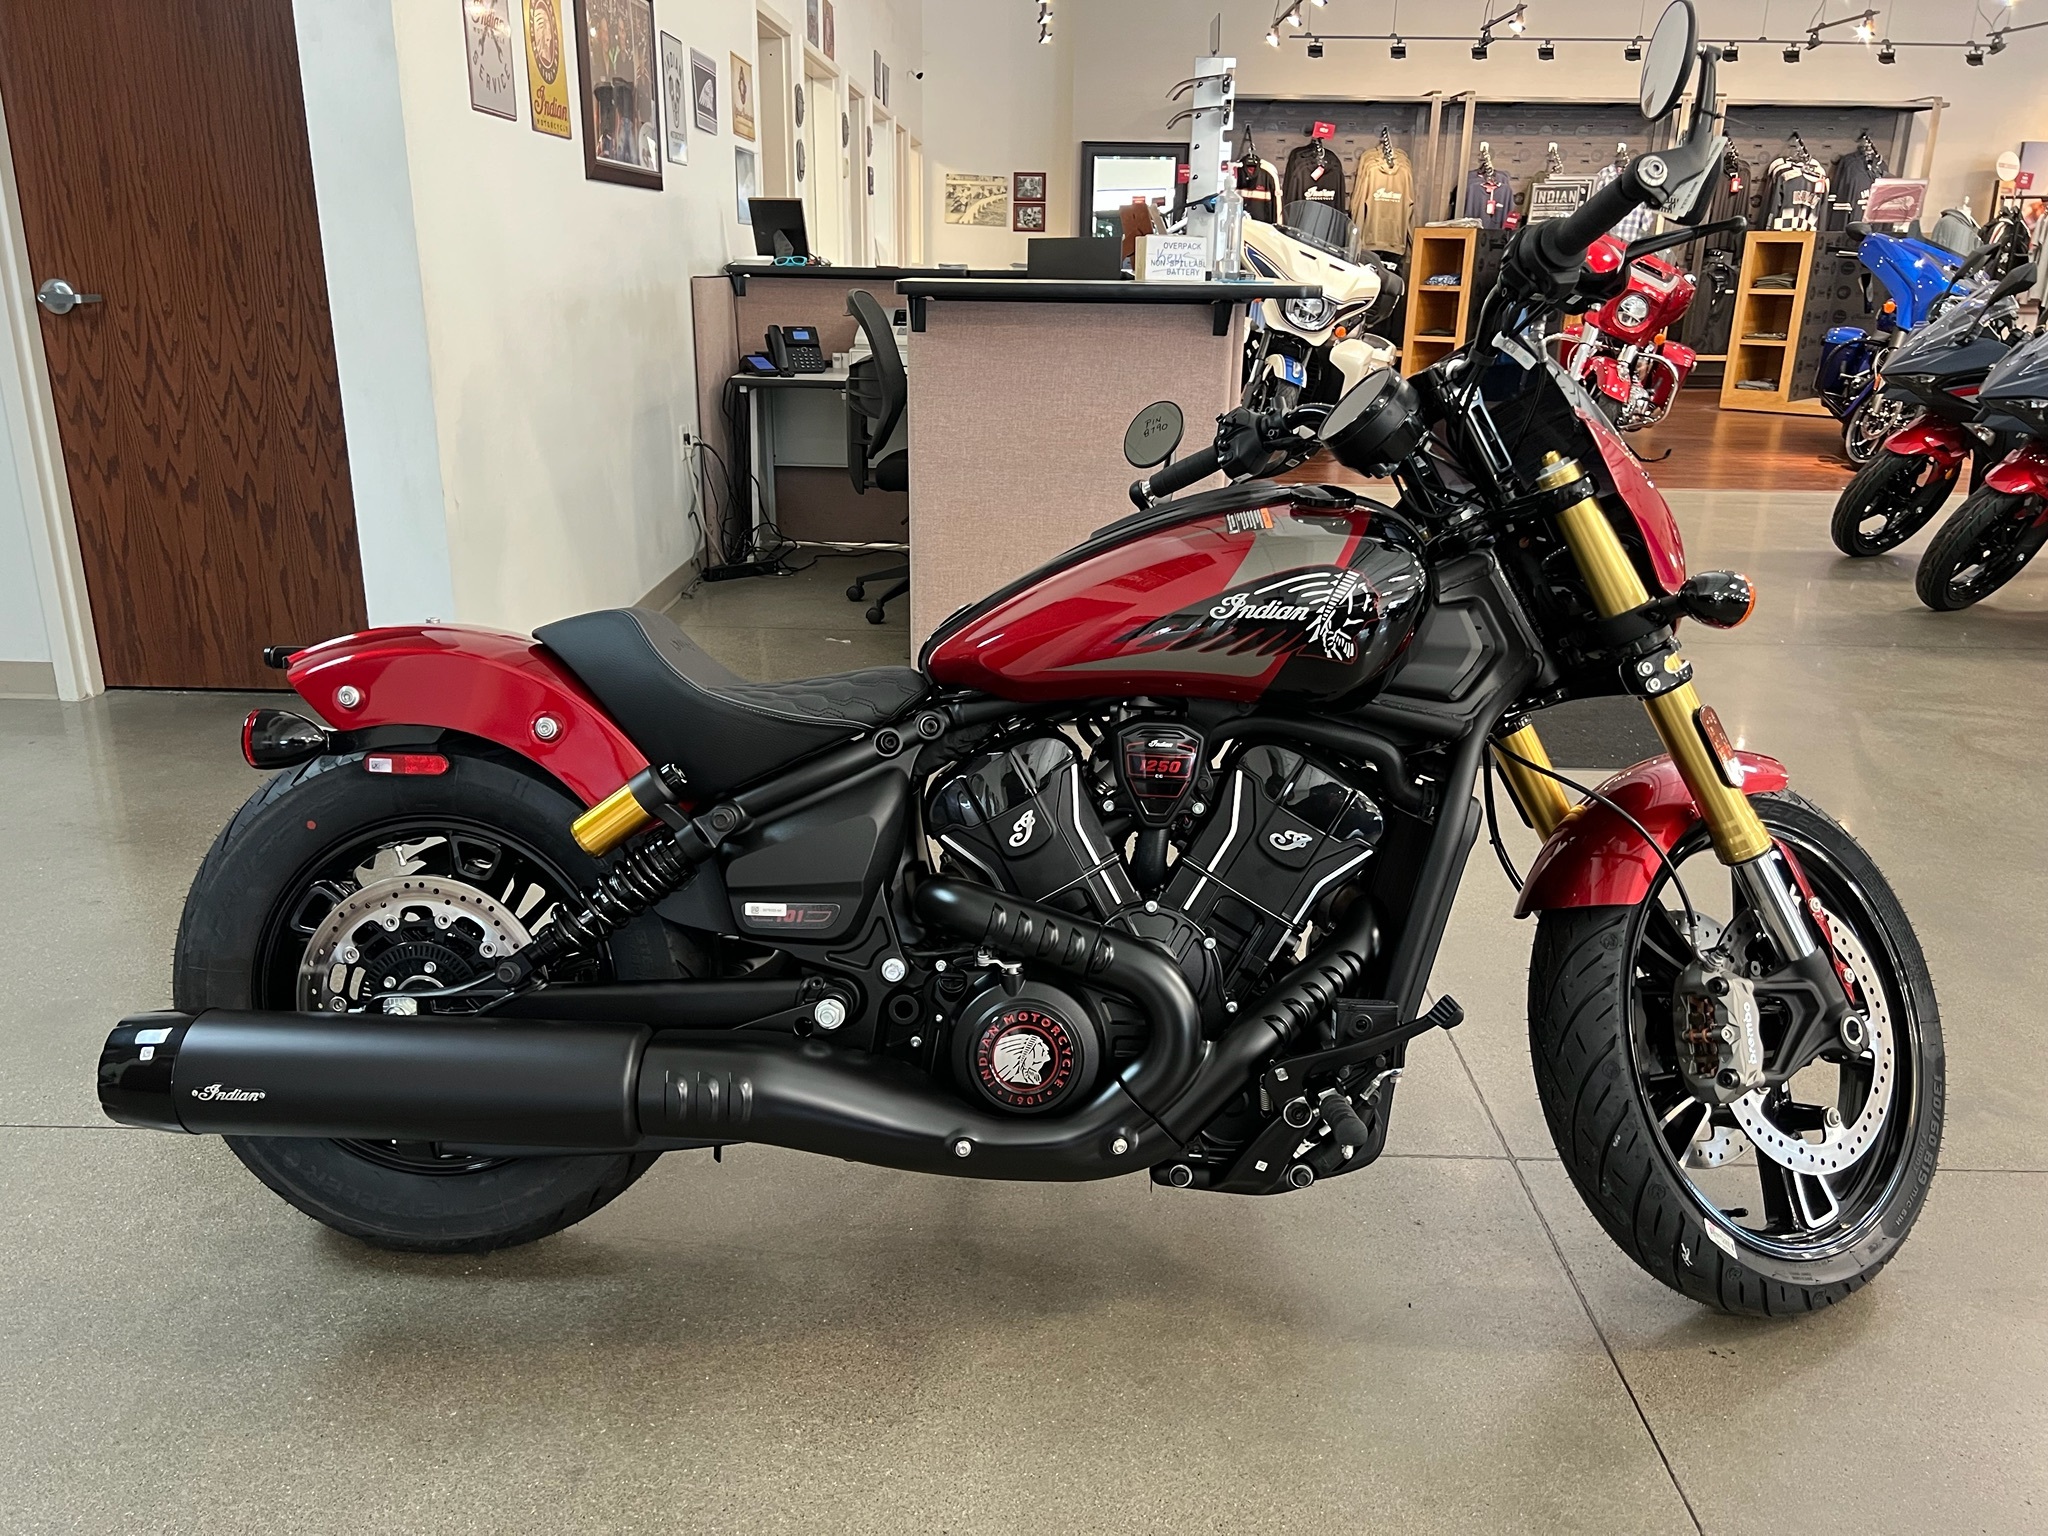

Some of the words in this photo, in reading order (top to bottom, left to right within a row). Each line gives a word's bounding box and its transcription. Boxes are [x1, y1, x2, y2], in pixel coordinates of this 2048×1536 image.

[473, 50, 510, 94] SERVICE
[534, 85, 568, 122] Indian
[1534, 190, 1577, 204] INDIAN
[1163, 242, 1202, 250] OVERPACK
[1144, 416, 1162, 428] PIN
[1209, 592, 1310, 621] Indian
[1148, 739, 1174, 748] Indian
[1139, 760, 1182, 773] 1250
[1743, 1001, 1757, 1065] brembo
[979, 1024, 1000, 1088] INDIAN
[1003, 1012, 1072, 1088] MOTORCYCLE
[197, 1083, 261, 1102] Indian
